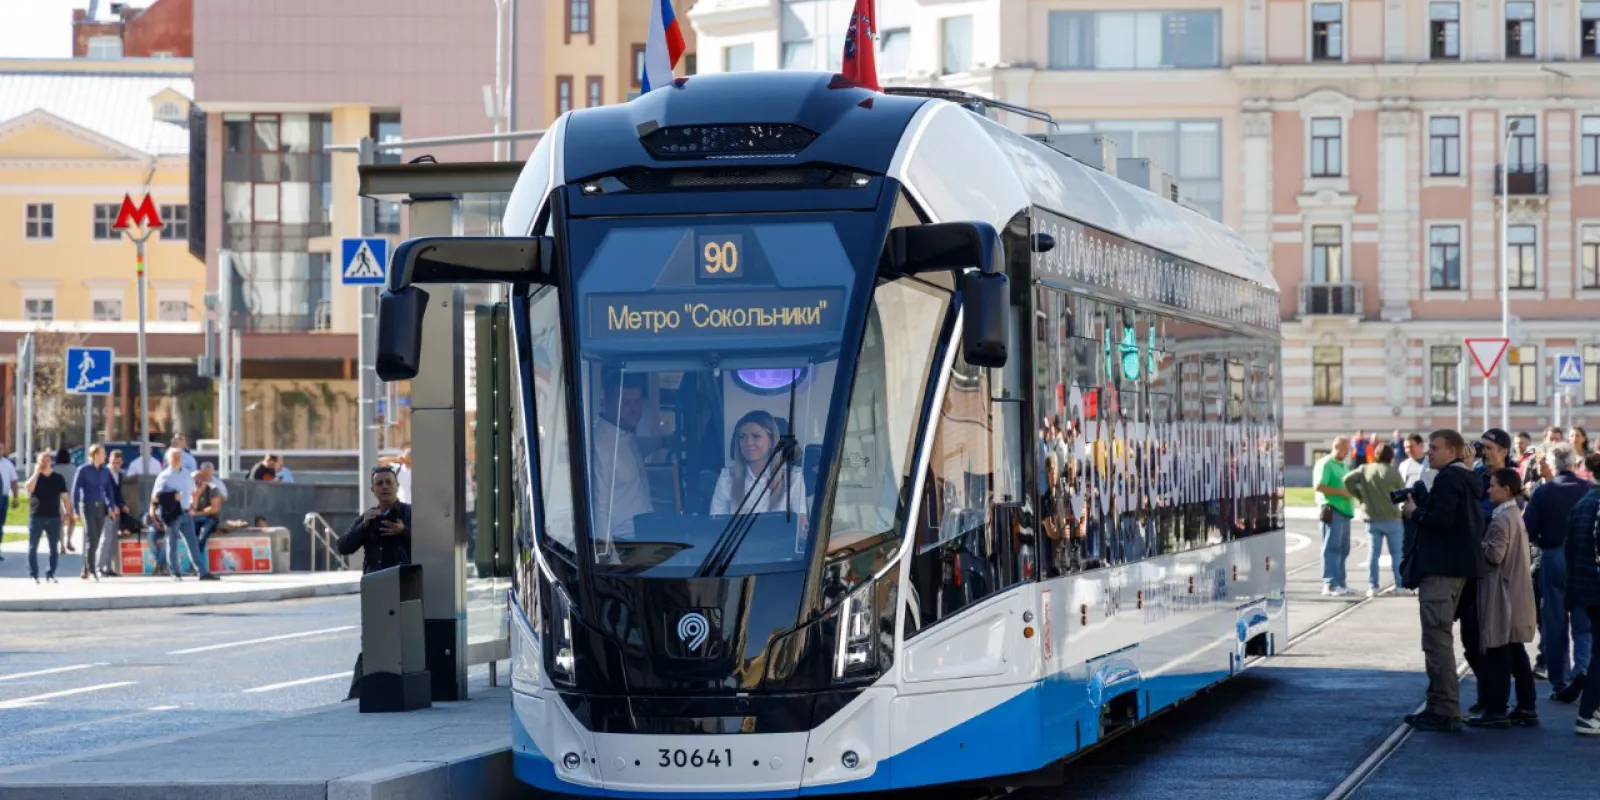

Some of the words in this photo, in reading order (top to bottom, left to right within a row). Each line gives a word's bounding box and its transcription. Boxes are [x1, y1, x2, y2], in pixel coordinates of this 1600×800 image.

[704, 241, 738, 274] 90
[607, 305, 680, 333] Метро
[684, 300, 828, 329] "Сокольники"
[658, 748, 732, 768] 30641
